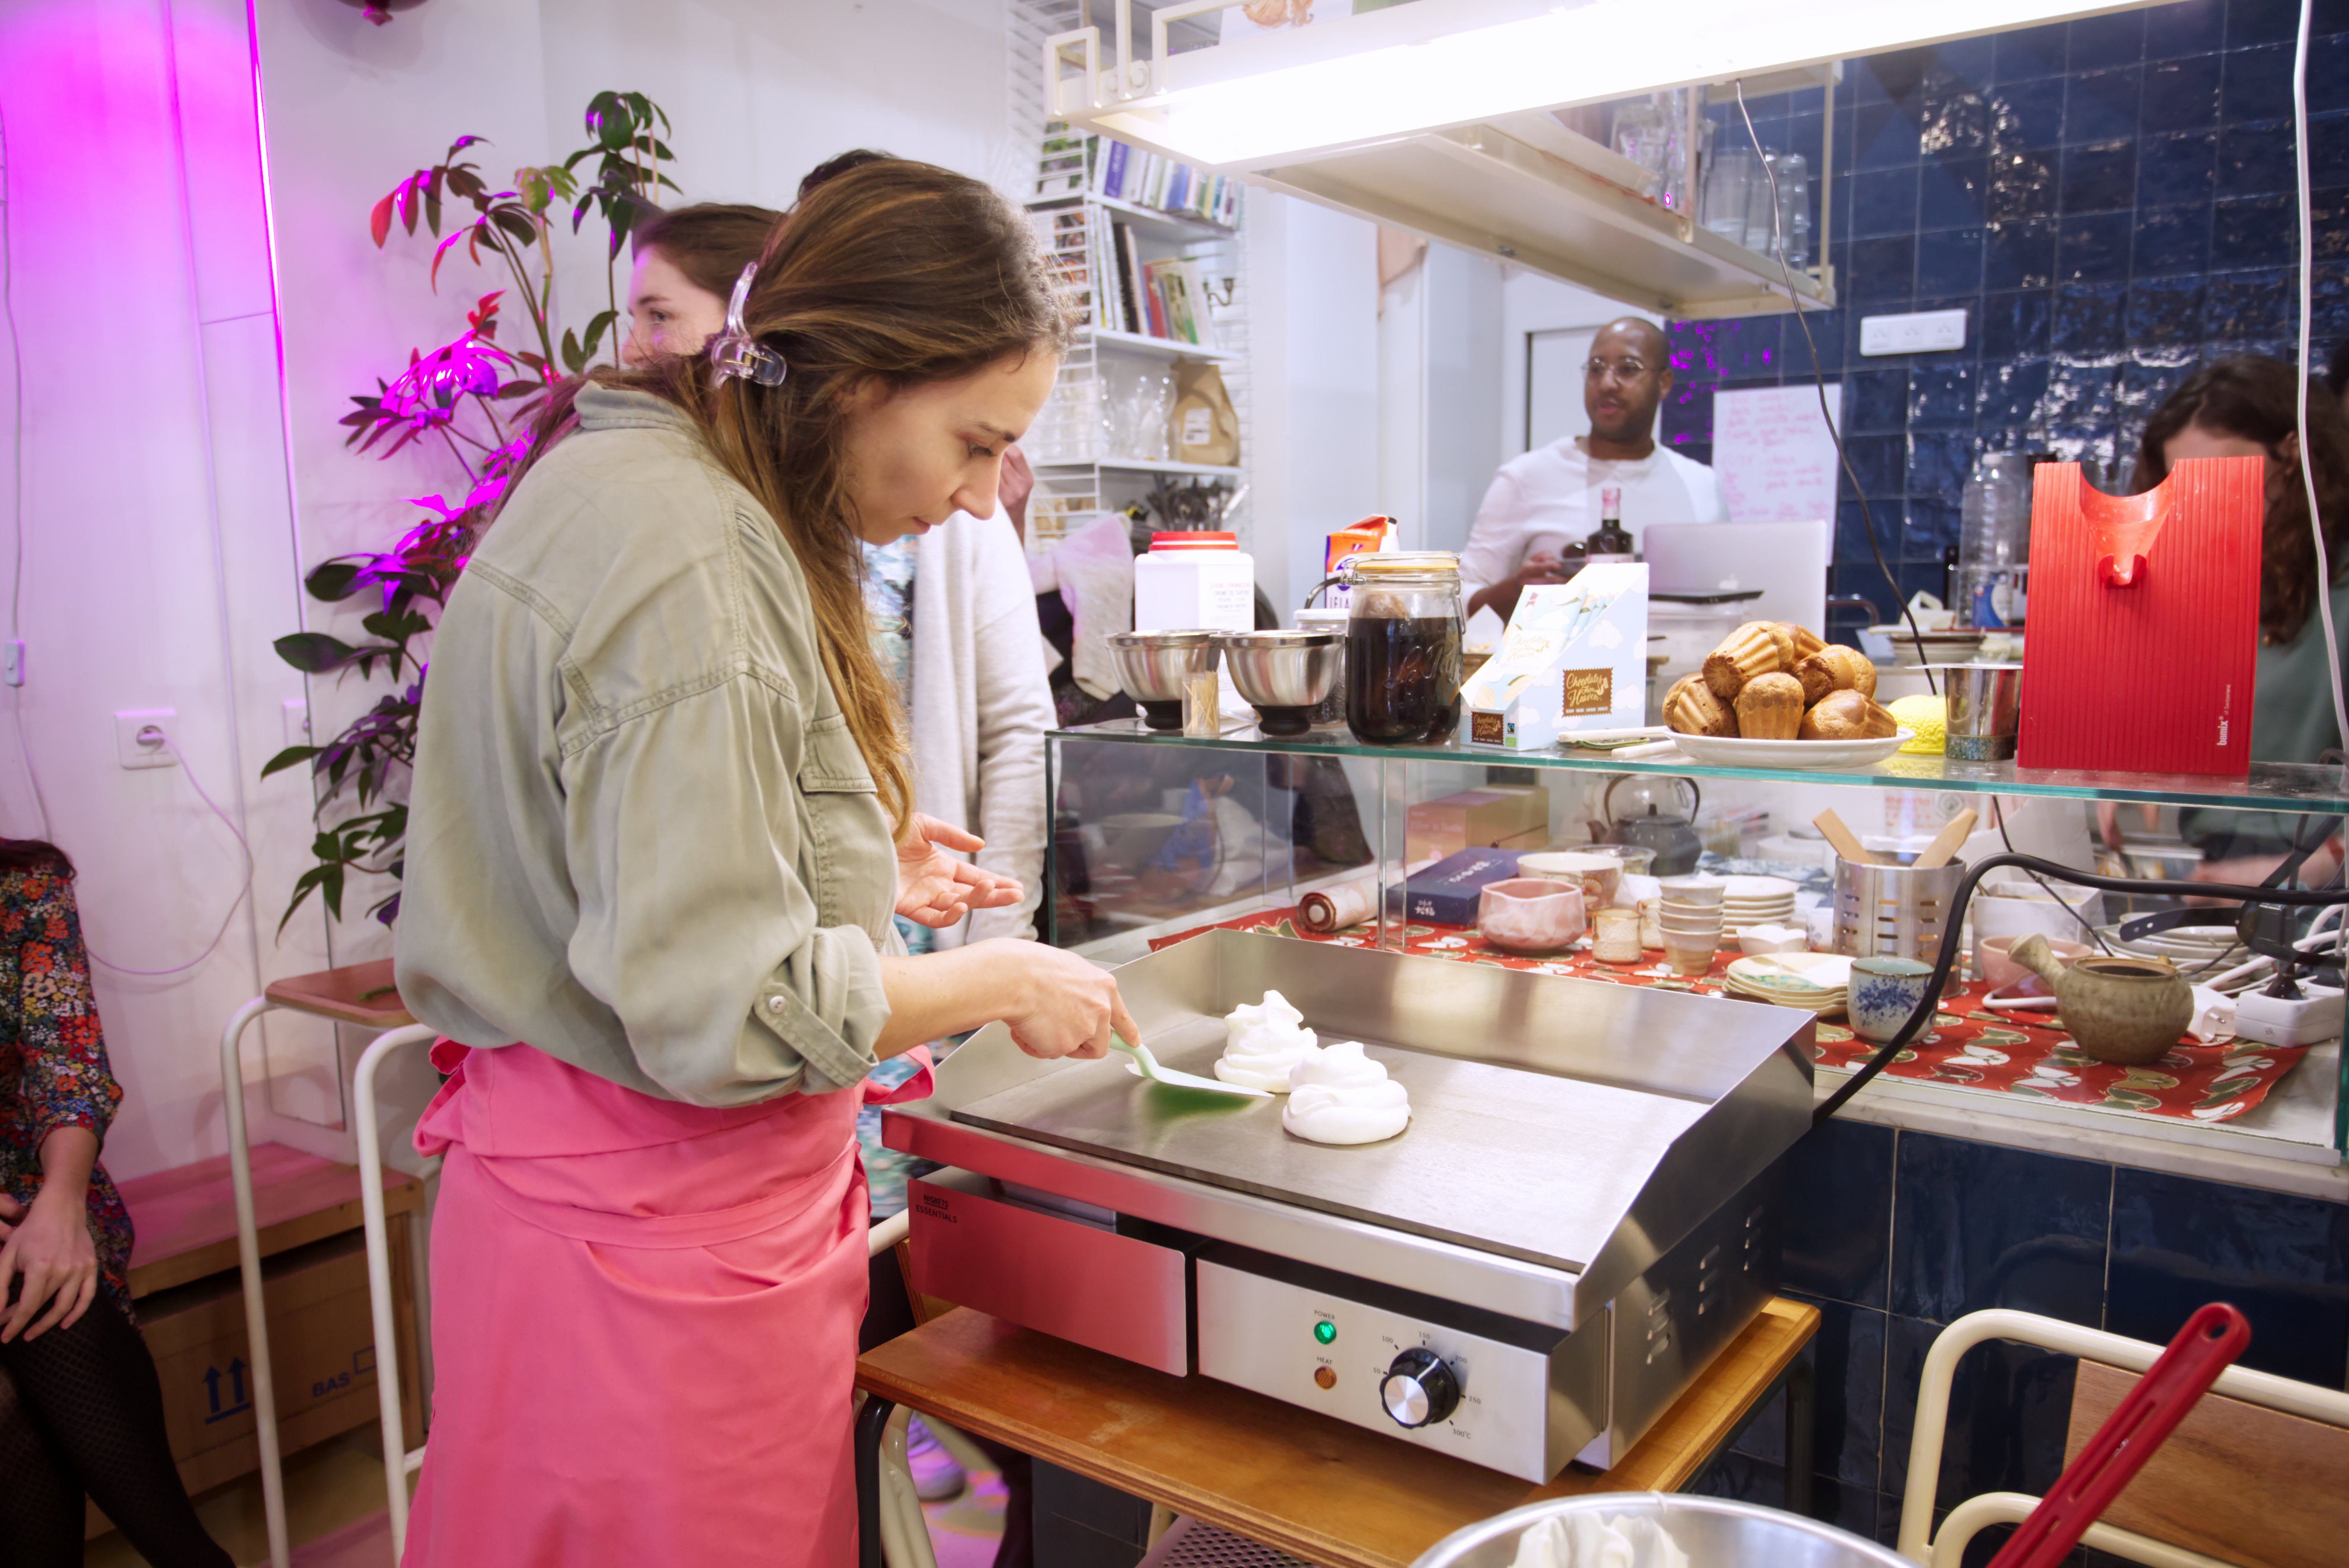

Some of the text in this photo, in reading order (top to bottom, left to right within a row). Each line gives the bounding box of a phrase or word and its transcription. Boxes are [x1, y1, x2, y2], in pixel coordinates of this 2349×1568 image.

[1566, 673, 1603, 690] Chocolates
[1567, 689, 1601, 707] Heaven
[924, 1194, 948, 1208] NISBETS
[916, 1204, 957, 1223] ESSENTIALS
[1314, 1309, 1335, 1320] POWER
[1317, 1356, 1333, 1365] HEAT
[1455, 1355, 1467, 1364] 200
[313, 1372, 351, 1399] BAS
[1469, 1395, 1481, 1405] 250
